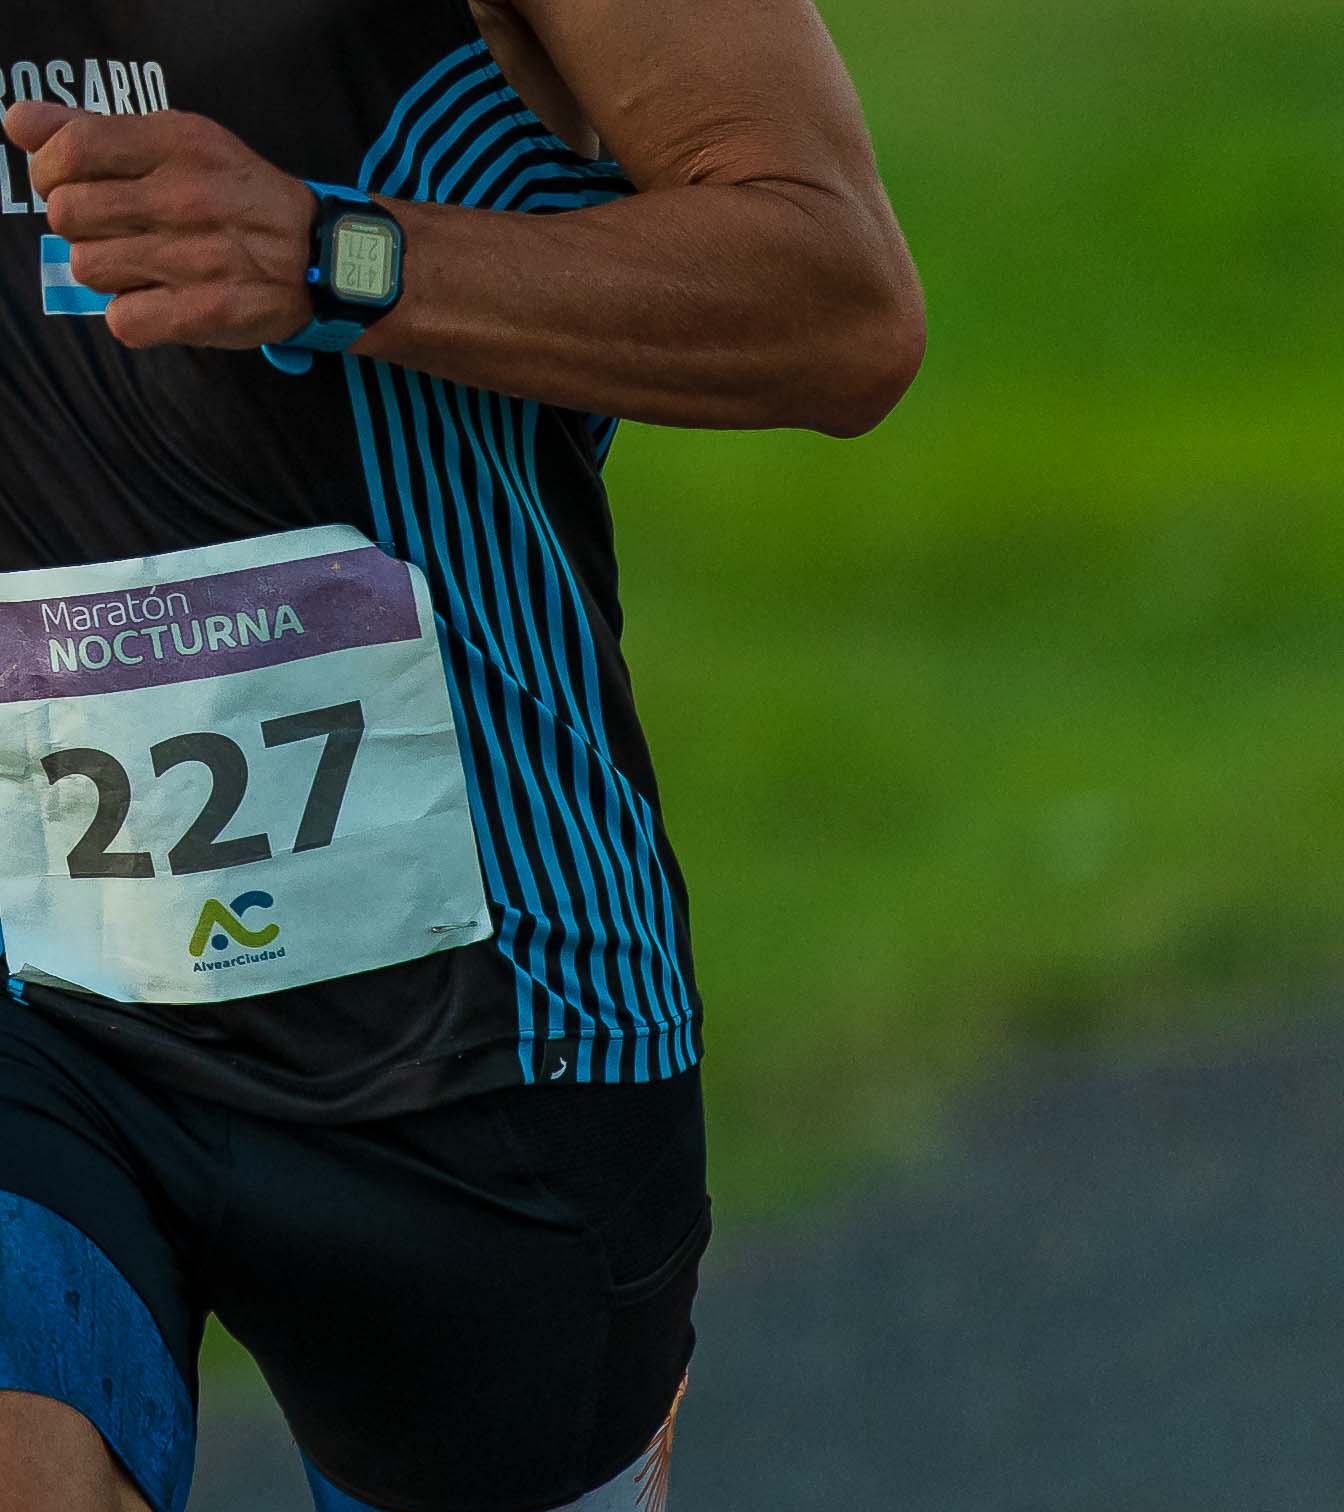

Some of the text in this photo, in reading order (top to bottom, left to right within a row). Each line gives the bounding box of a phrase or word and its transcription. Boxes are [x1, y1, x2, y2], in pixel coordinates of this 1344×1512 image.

[41, 586, 191, 632] Maratón
[48, 604, 305, 673] NOCTURNA
[40, 700, 365, 879] 227
[193, 947, 286, 972] AlvearCiudad
